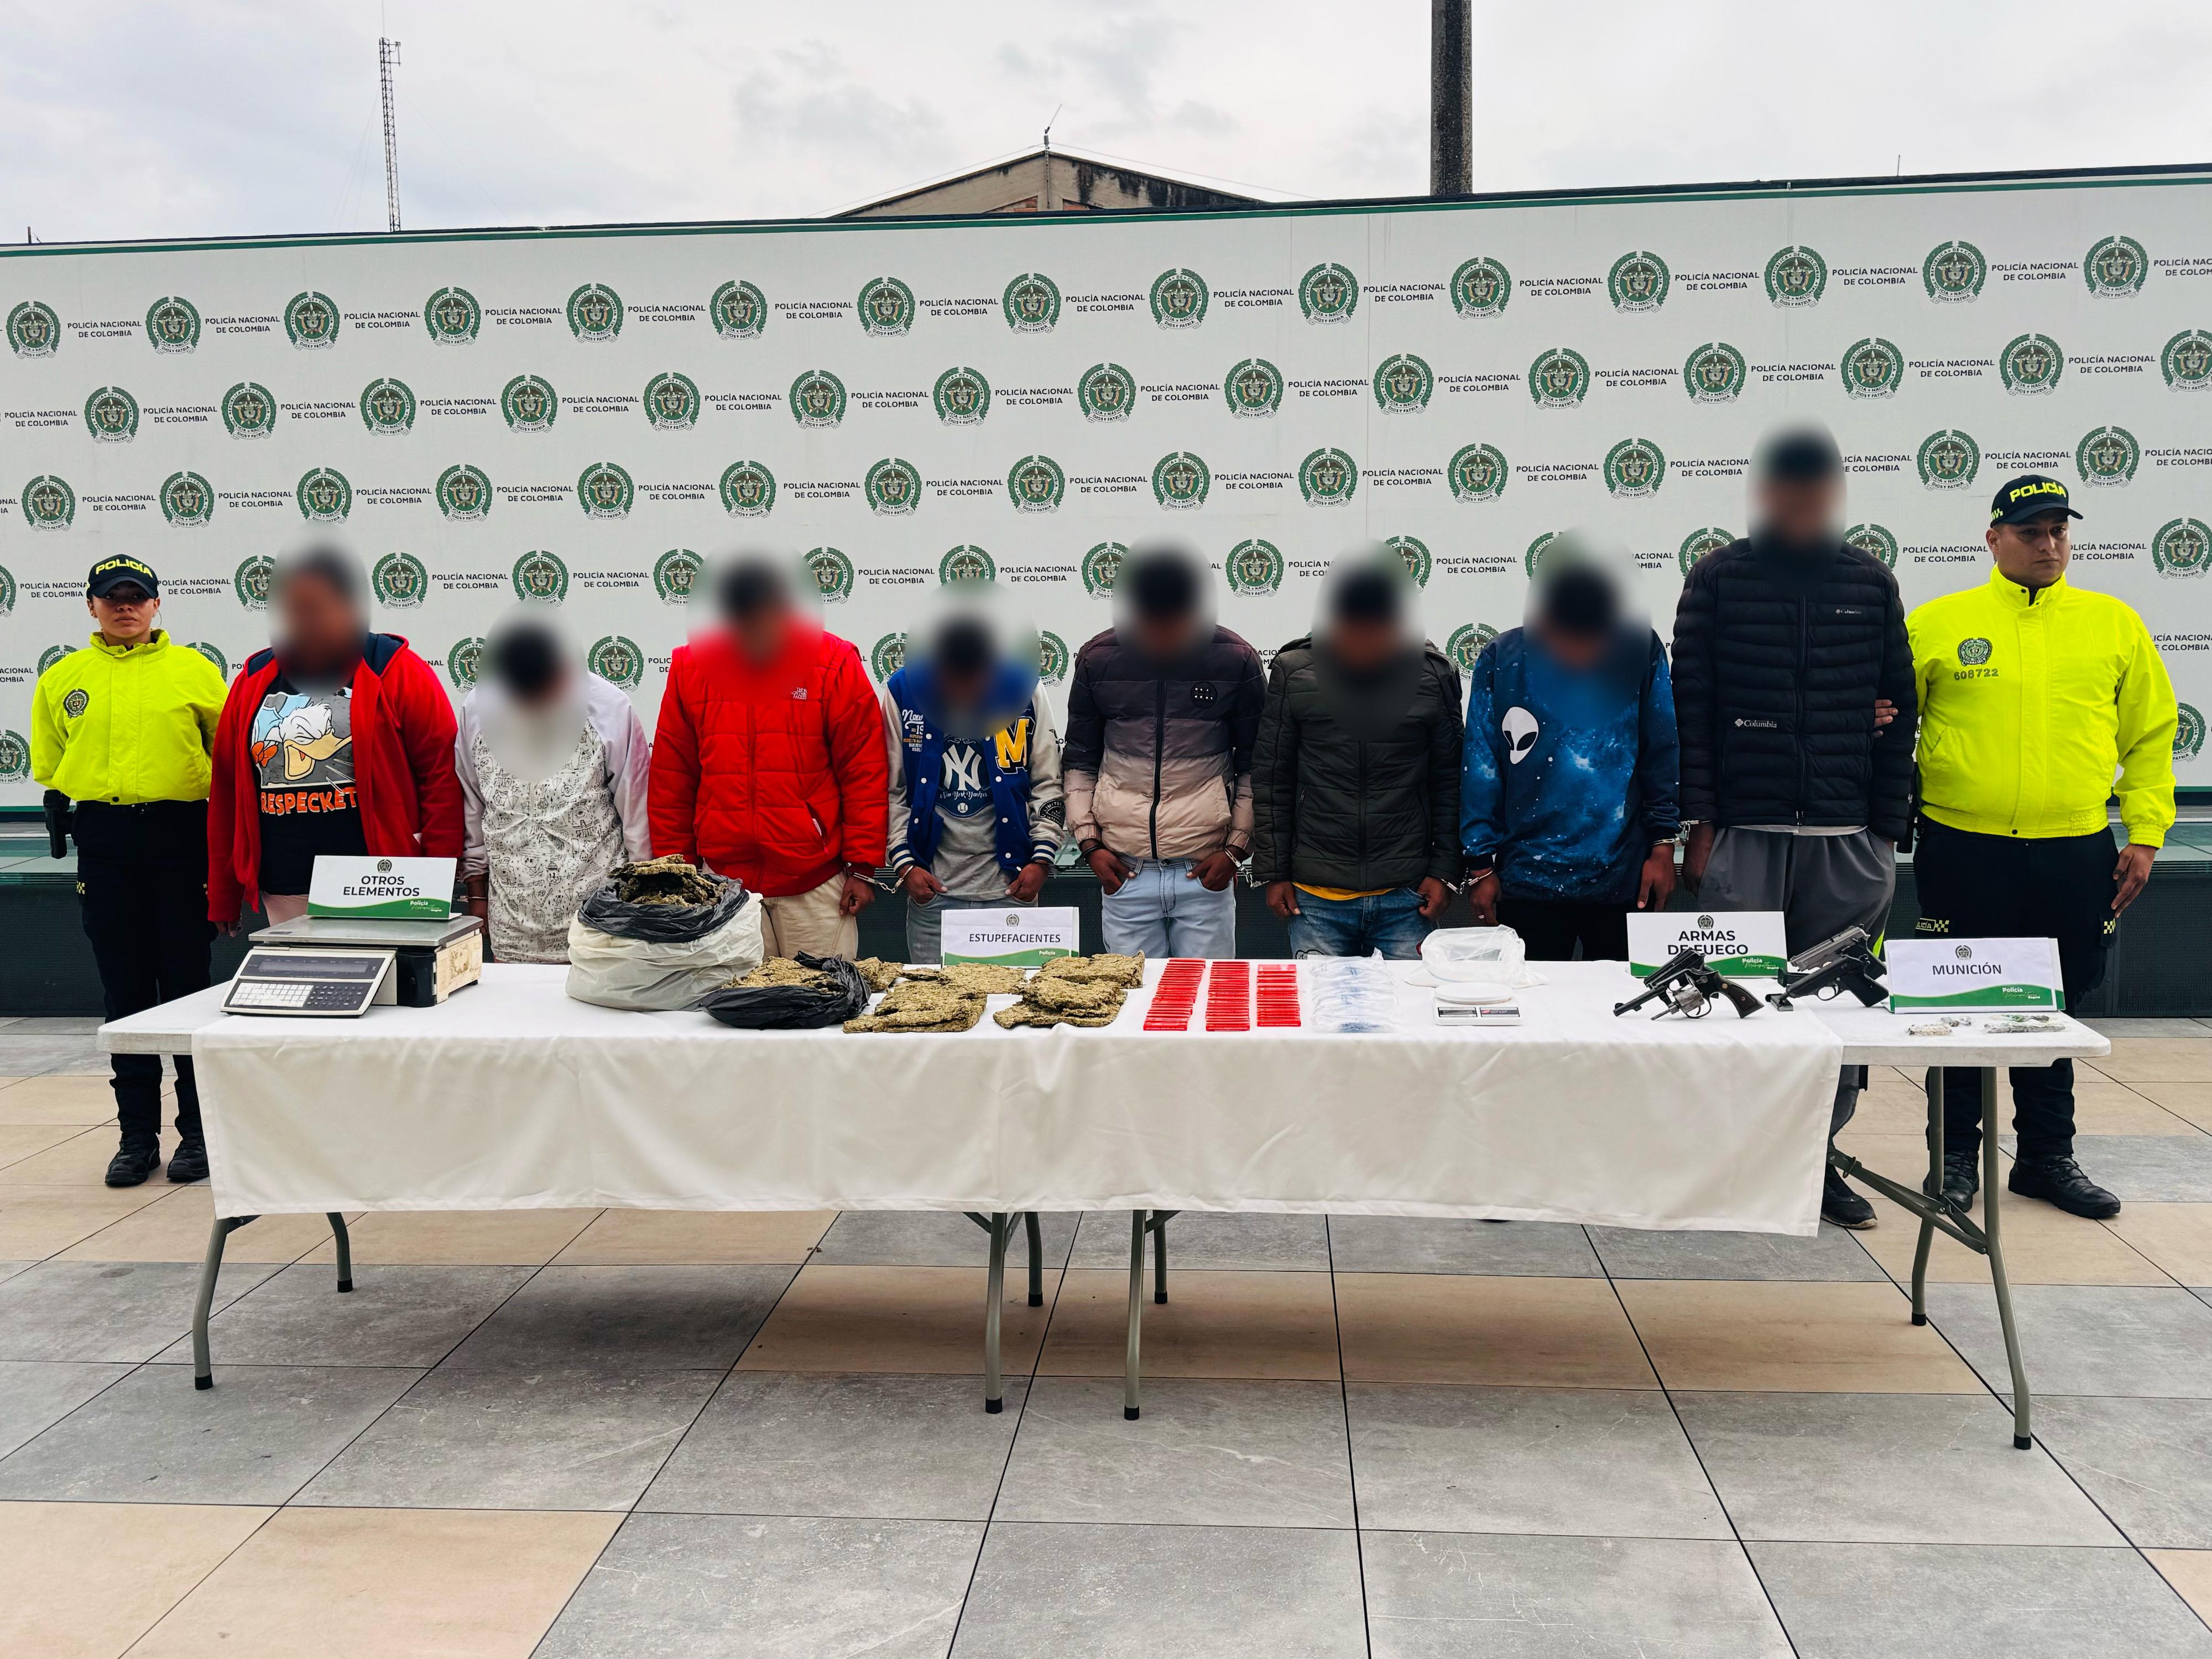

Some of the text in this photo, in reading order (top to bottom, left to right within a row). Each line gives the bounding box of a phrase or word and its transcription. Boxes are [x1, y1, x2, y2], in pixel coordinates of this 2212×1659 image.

[1832, 267, 1918, 276] POLICÍA NACIONAL
[1519, 277, 1604, 287] POLICÍA NACIONAL
[1858, 277, 1906, 285] COLOMBIA
[1213, 288, 1295, 298] POLICÍA NACIONAL
[1544, 287, 1592, 296] COLOMBIA
[920, 298, 953, 307] POLICÍA
[1238, 299, 1283, 307] COLOMBIA
[628, 304, 661, 313] POLICÍA
[344, 311, 376, 320] POLICÍA
[67, 320, 99, 329] POLICÍA
[2068, 354, 2156, 364] POLICÍA NACIONAL
[1751, 363, 1837, 373] POLICÍA NACIONAL
[2094, 365, 2143, 373] COLOMBIA
[1438, 374, 1521, 383] POLICÍA NACIONAL
[1140, 383, 1220, 393] POLICÍA NACIONAL
[1463, 384, 1509, 392] COLOMBIA
[851, 390, 884, 399] POLICÍA
[1164, 393, 1209, 401] COLOMBIA
[562, 395, 595, 404] POLICÍA
[280, 401, 312, 410] POLICÍA
[1985, 451, 2021, 460] POLICÍA
[1516, 463, 1599, 473] POLICÍA NACIONAL
[1214, 472, 1248, 481] POLICÍA
[638, 483, 671, 491] POLICÍA
[926, 478, 959, 487] POLICÍA
[356, 487, 388, 495] POLICÍA
[82, 494, 113, 503] POLICÍA
[1902, 545, 1939, 554] POLICÍA
[2070, 542, 2097, 551] LICÍA
[1436, 556, 1470, 565] POLICÍA
[1000, 565, 1033, 573] POLICÍA
[573, 571, 606, 579] POLICÍA
[156, 578, 189, 587] POLICÍA
[1954, 668, 1999, 681] 608722
[1744, 719, 1777, 728] Columbia
[361, 875, 405, 885] OTROS
[343, 886, 420, 897] ELEMENTOS
[969, 933, 1061, 943] ESTUPEFACIENTES
[1678, 930, 1736, 941] ARMAS
[1694, 944, 1749, 955] FUEGO
[1932, 962, 2002, 975] MUNICIÓN
